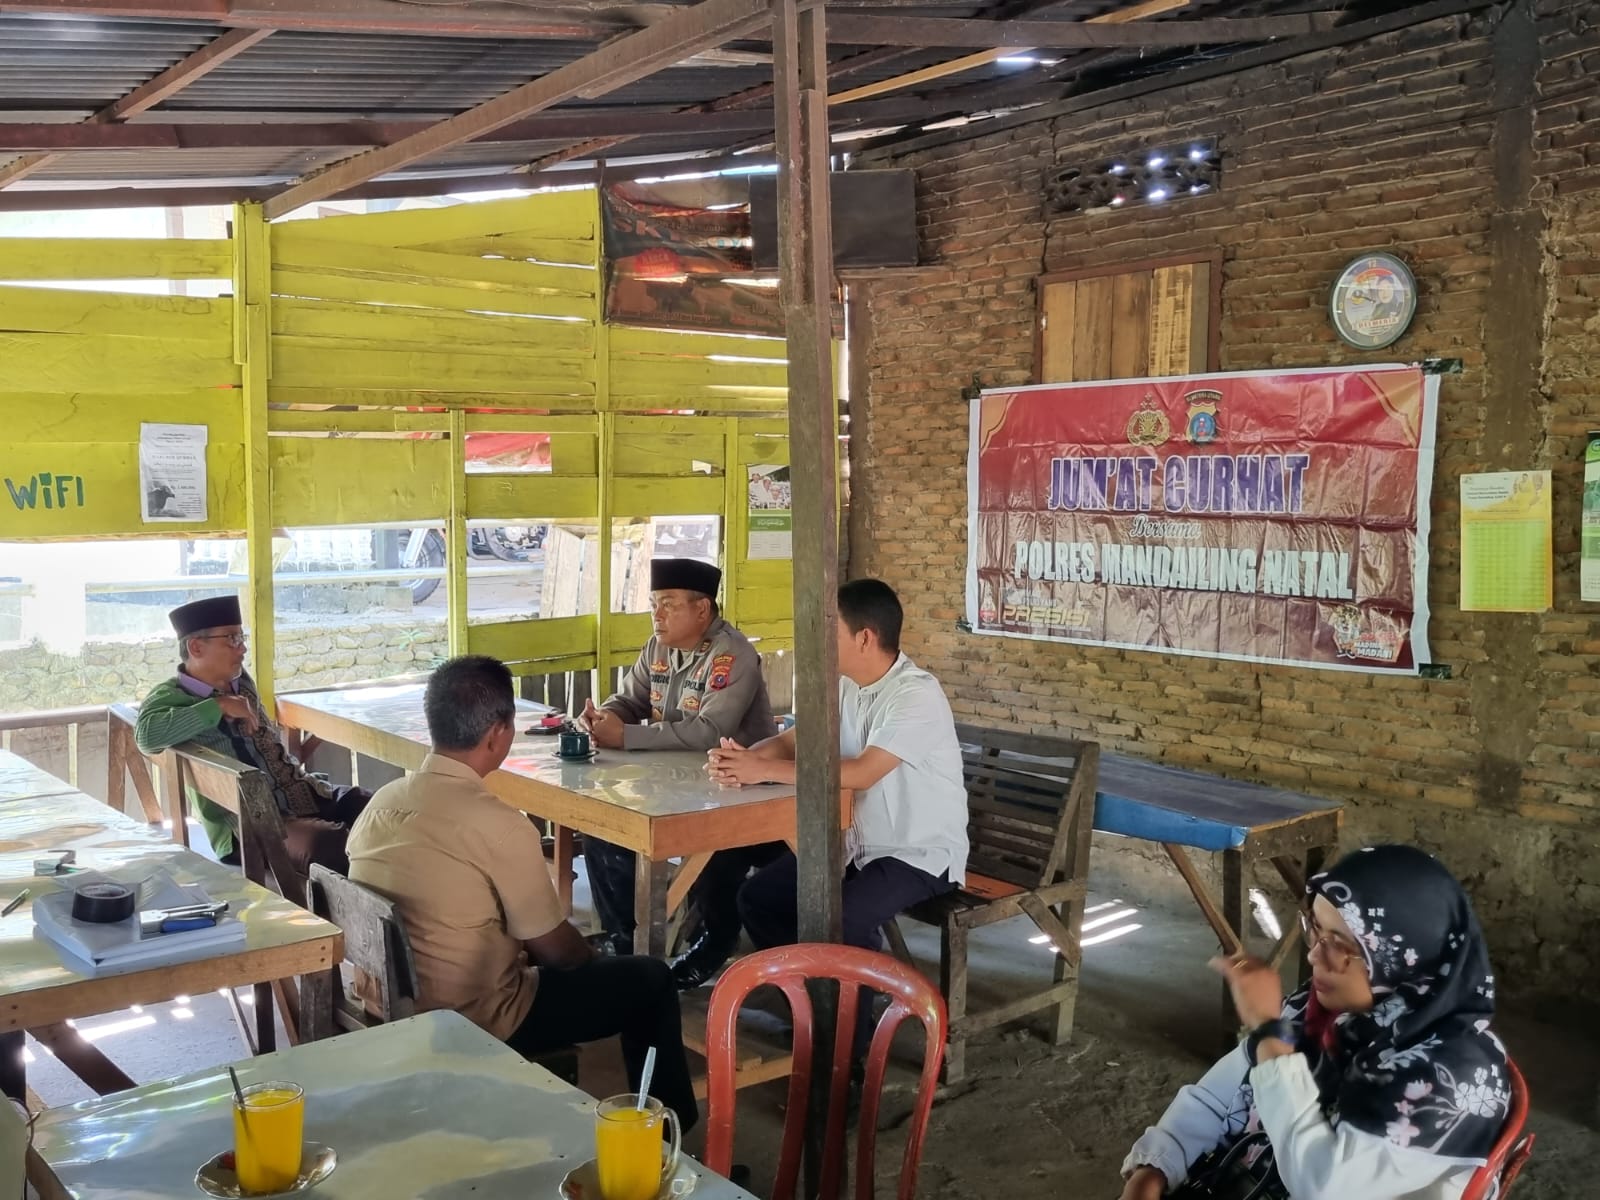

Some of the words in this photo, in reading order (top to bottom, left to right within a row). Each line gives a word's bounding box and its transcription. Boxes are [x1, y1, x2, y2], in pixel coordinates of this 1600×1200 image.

[1048, 457, 1158, 510] JUM'AT
[1163, 455, 1310, 513] CURHAT
[1130, 514, 1201, 538] Bersama
[1014, 541, 1096, 583] POLRES
[1101, 543, 1257, 594] MANDAILING
[1263, 550, 1353, 599] NATAL
[1003, 605, 1091, 627] PRESISI
